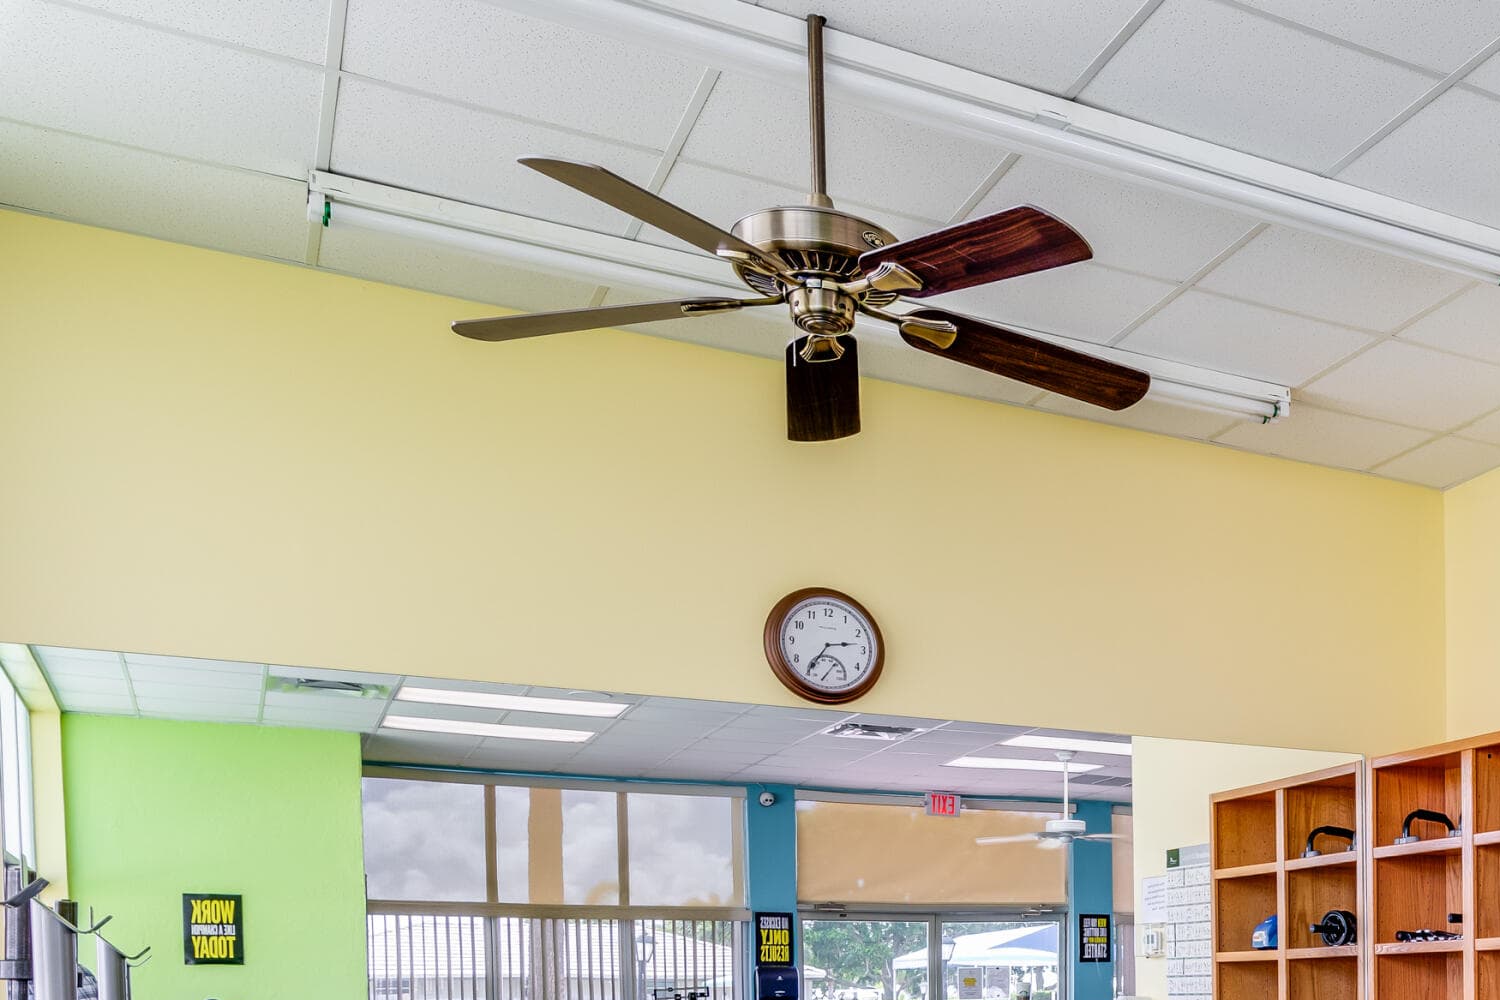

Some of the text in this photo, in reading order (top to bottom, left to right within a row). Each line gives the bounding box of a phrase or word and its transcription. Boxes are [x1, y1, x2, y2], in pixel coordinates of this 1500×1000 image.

[808, 610, 816, 620] 11
[823, 608, 834, 618] 12
[843, 615, 848, 624] 1
[795, 620, 804, 630] 10
[855, 629, 861, 638] 2
[789, 636, 795, 645] 9
[860, 646, 866, 655] 3
[794, 654, 799, 663] 8
[854, 662, 860, 671] 4
